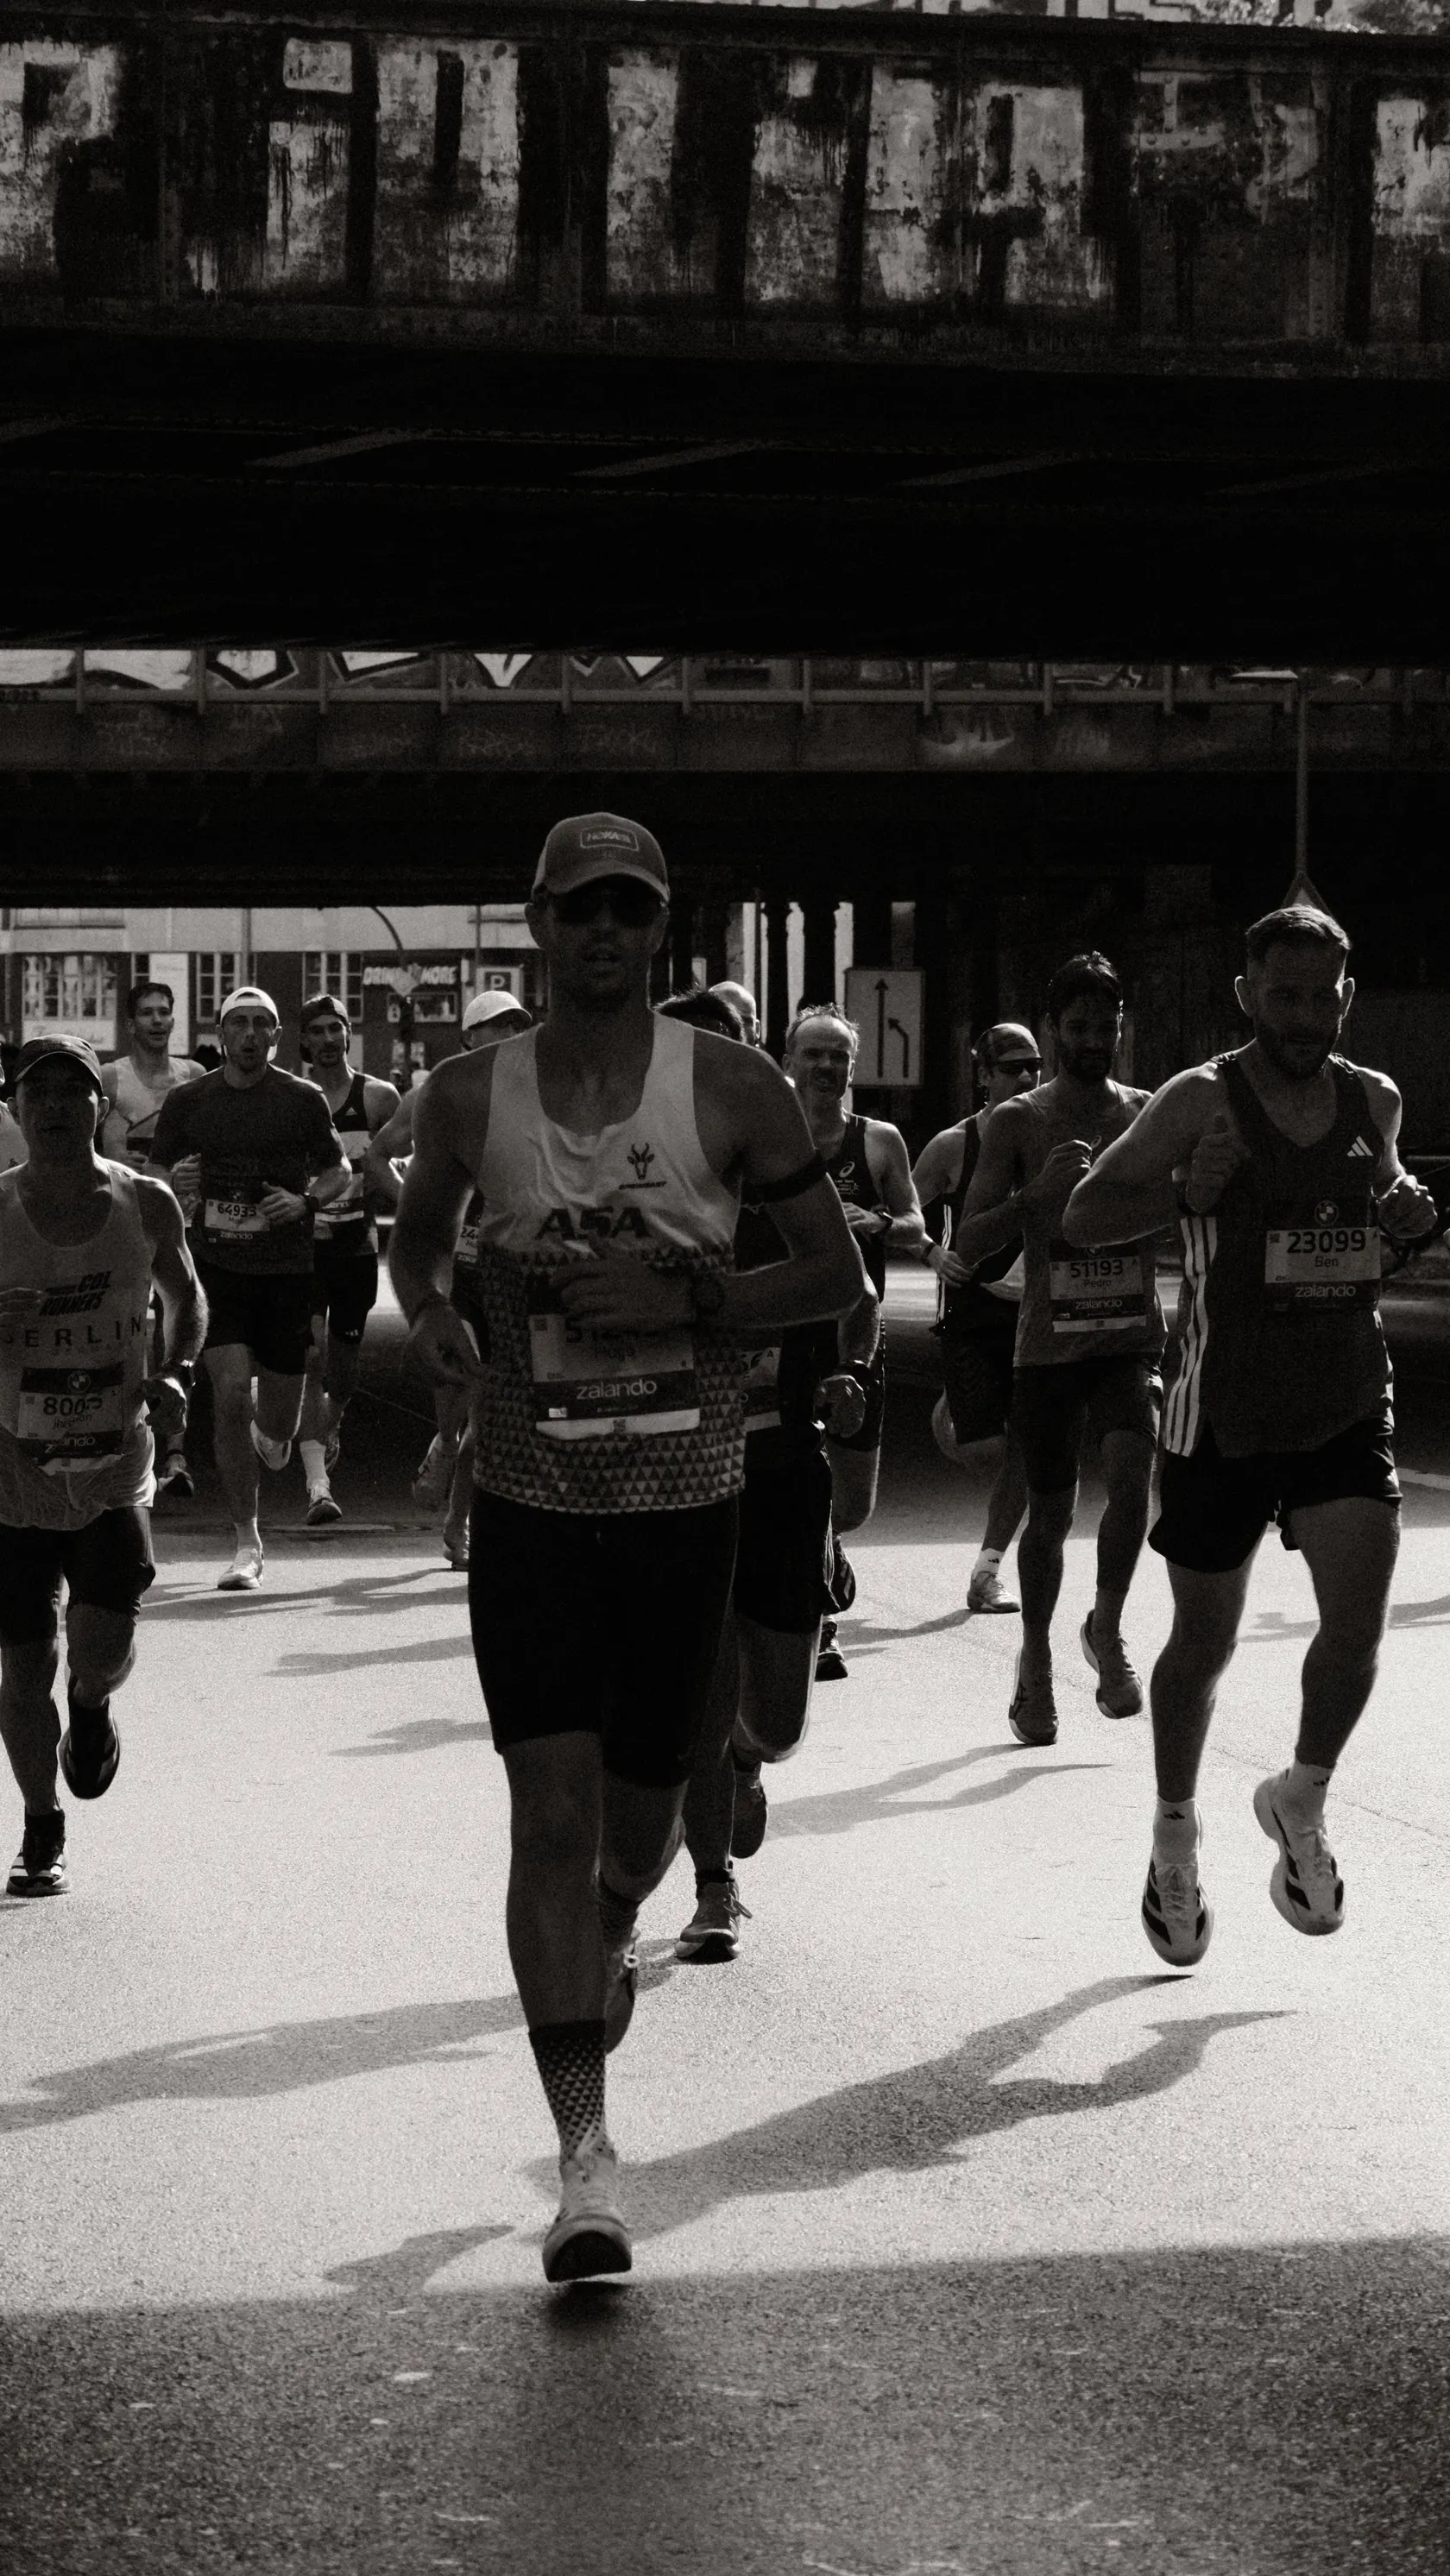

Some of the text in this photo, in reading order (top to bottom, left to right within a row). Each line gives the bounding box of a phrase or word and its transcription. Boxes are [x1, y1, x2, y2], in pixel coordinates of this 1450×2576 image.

[489, 975, 506, 991] P
[218, 1204, 257, 1218] 64933
[1287, 1229, 1365, 1254] 23099
[1070, 1259, 1124, 1278] 51193
[1314, 1256, 1339, 1268] Ben
[1084, 1278, 1113, 1288] Pedro
[1295, 1284, 1357, 1298] zalando
[1075, 1297, 1123, 1310] zalando
[576, 1380, 659, 1401] zalando
